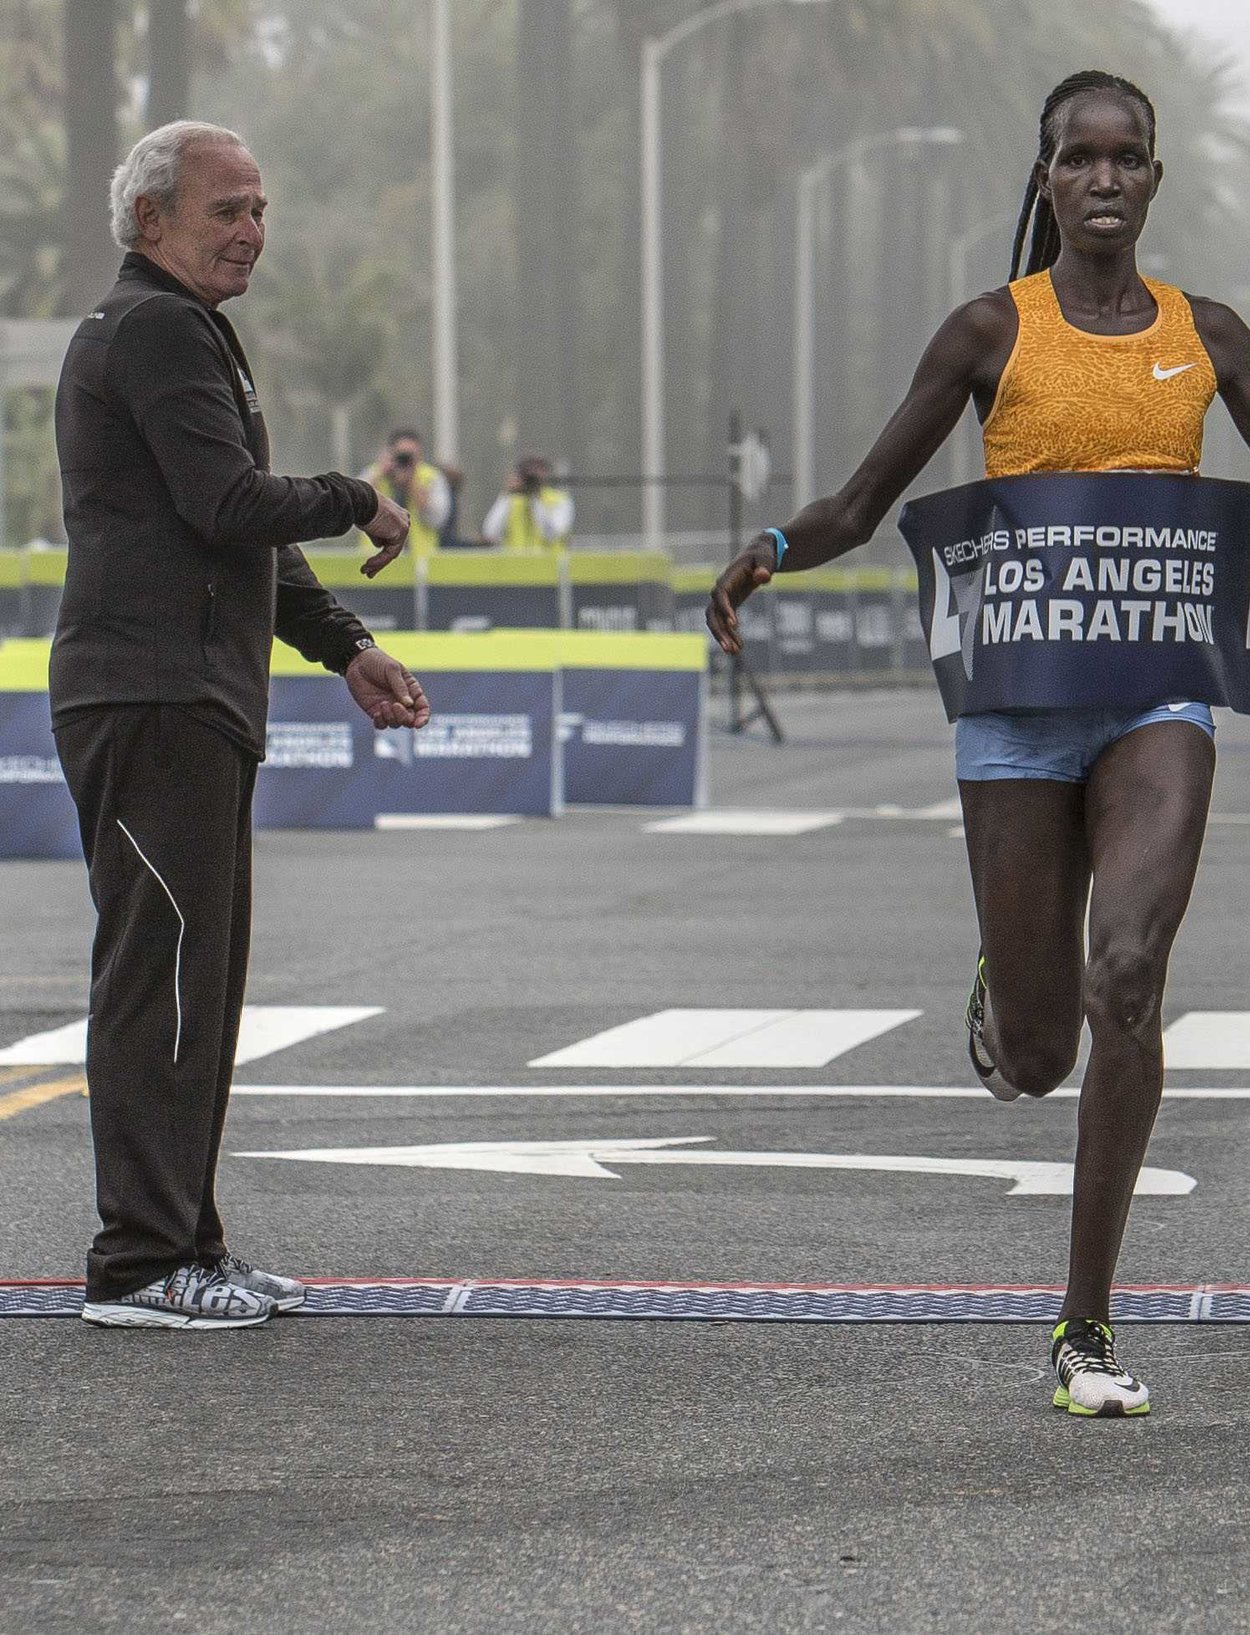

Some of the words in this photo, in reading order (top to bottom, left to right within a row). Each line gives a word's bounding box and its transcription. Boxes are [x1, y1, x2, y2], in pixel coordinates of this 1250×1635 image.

[944, 530, 1009, 566] SKECHERS
[1015, 525, 1217, 551] PERFORMANCE
[984, 557, 1045, 595] LOS
[1063, 557, 1214, 596] ANGELES
[982, 599, 1215, 645] MARATHON
